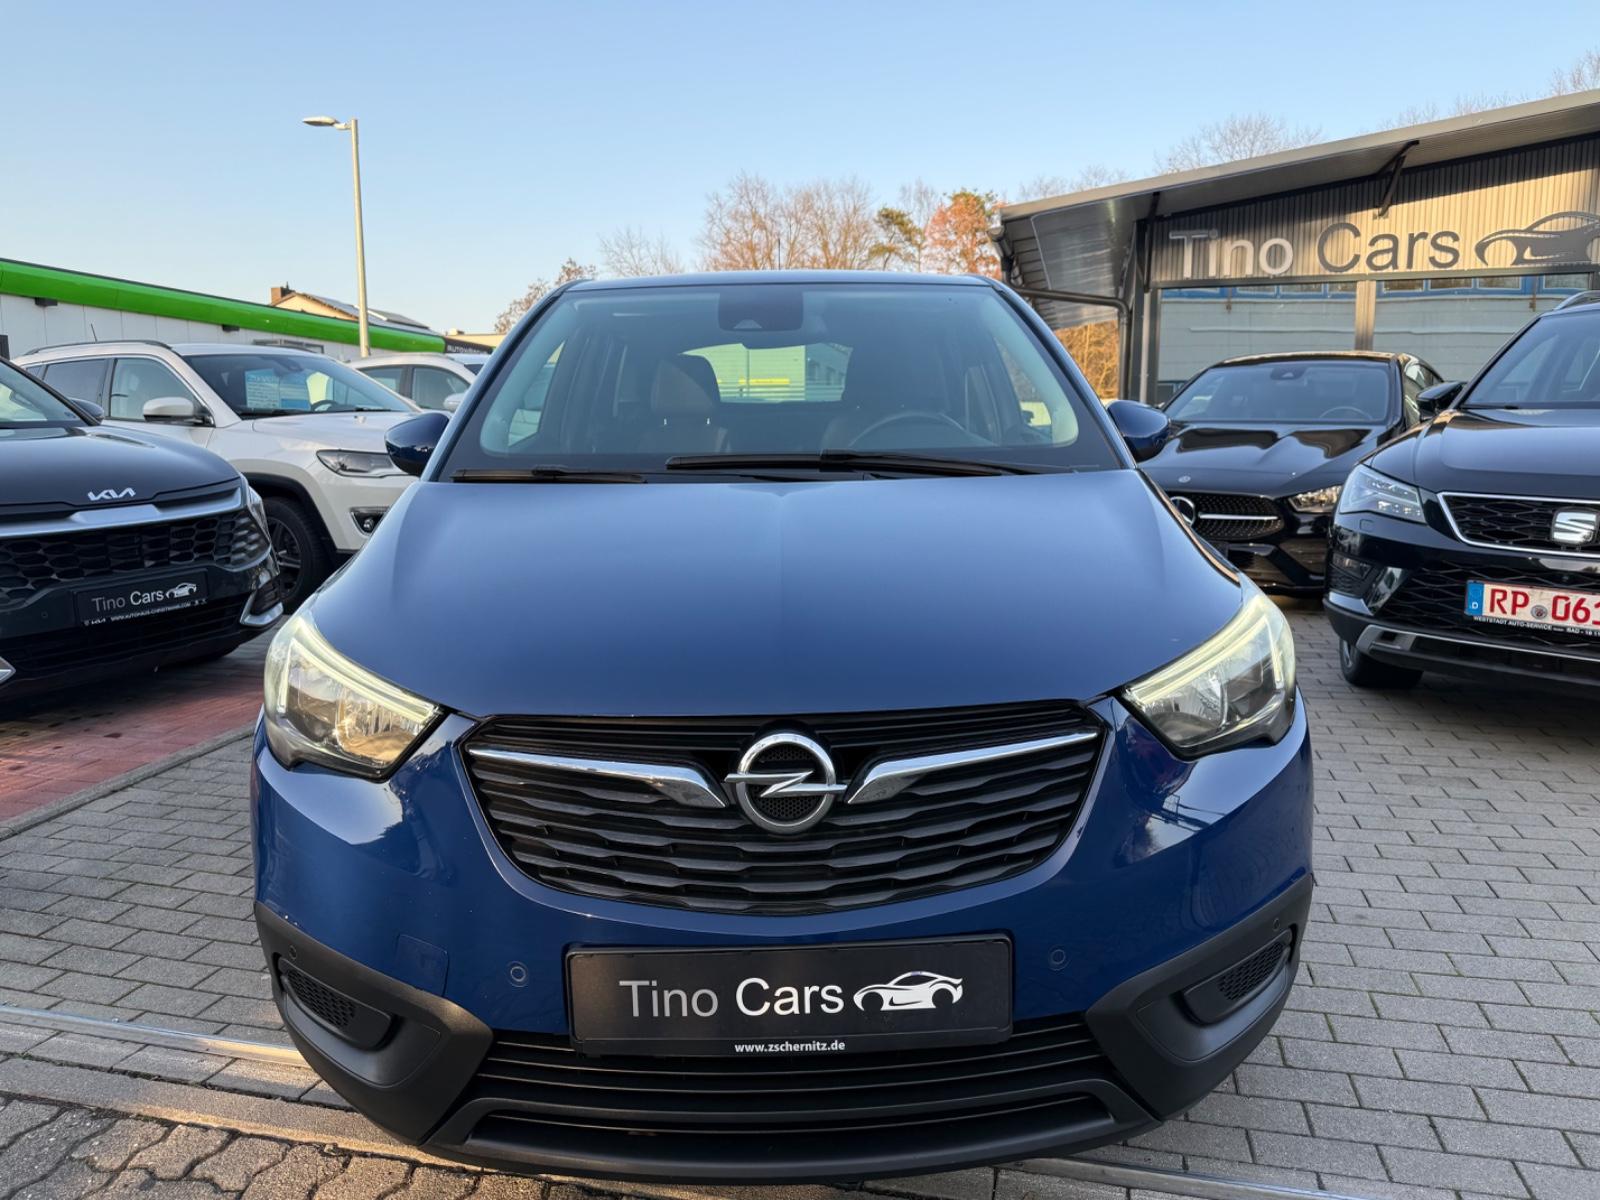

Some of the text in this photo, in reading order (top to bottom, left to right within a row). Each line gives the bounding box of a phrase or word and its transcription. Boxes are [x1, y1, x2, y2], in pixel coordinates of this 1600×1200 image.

[1169, 222, 1460, 279] Tino Cars
[88, 487, 136, 501] KIA
[91, 590, 164, 612] Tino Cars
[1489, 588, 1530, 616] RP
[618, 977, 845, 1017] Tino Cars
[734, 1040, 846, 1053] www.zschernitz.de
